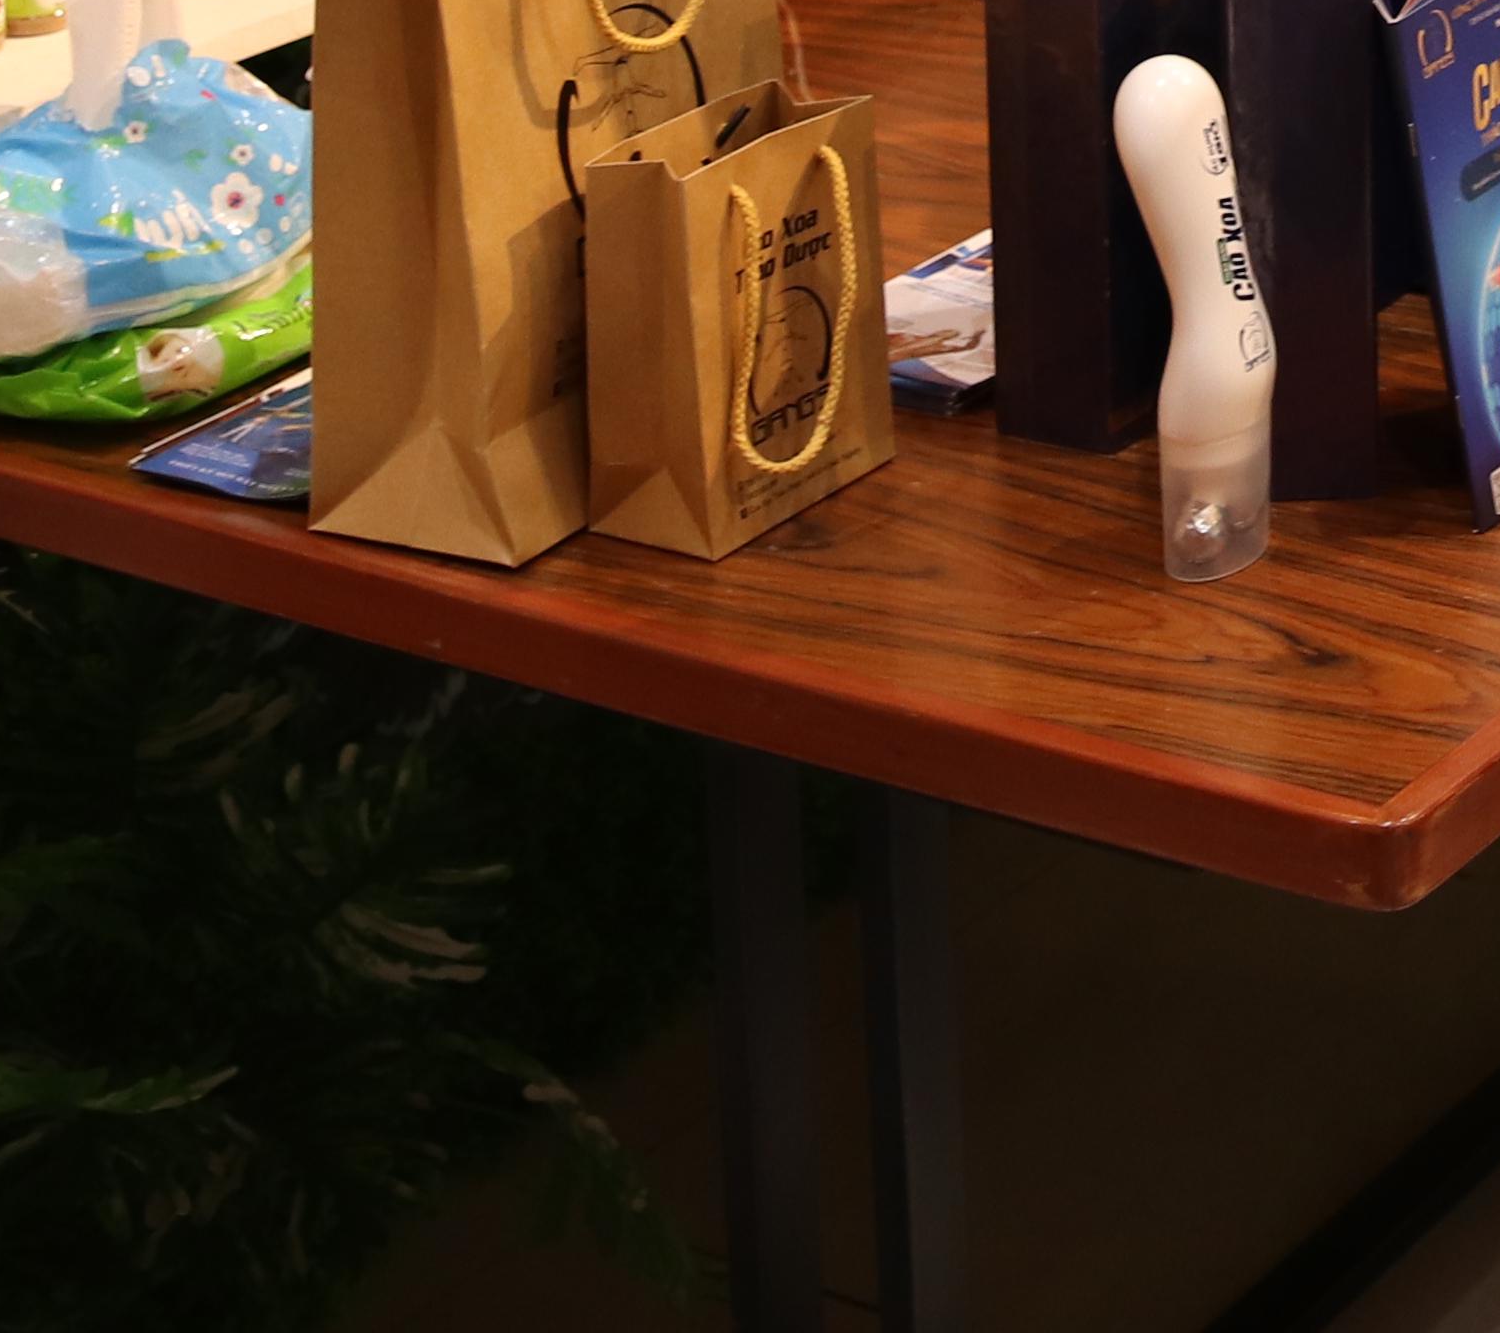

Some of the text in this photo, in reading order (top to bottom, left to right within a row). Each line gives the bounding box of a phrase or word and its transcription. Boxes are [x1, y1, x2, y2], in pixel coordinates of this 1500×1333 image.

[781, 208, 818, 237] Xoa
[1217, 197, 1257, 303] CAO XOA
